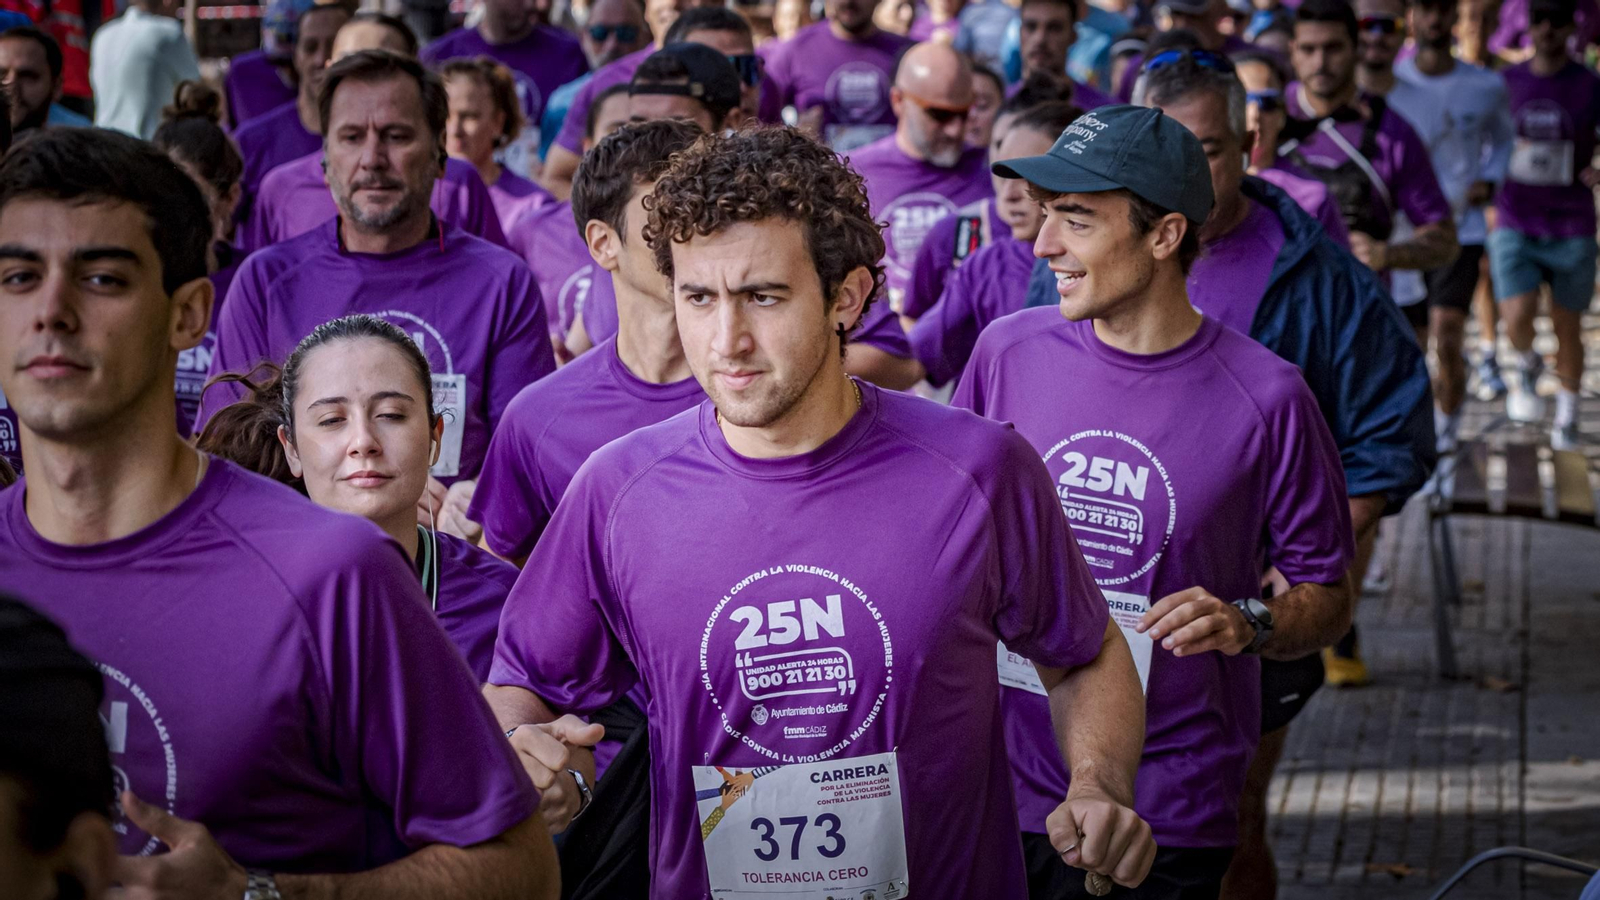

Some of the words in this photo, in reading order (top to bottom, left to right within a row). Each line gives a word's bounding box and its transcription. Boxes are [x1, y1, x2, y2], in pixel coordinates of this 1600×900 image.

[1070, 429, 1101, 442] CONTRA
[1103, 430, 1114, 438] LA
[1115, 431, 1153, 459] VIOLENCIA
[1059, 451, 1150, 501] 25N
[1150, 456, 1169, 481] HACIA
[1164, 481, 1175, 498] LAS
[1088, 511, 1103, 525] 21
[1104, 514, 1119, 528] 21
[1119, 518, 1138, 532] 30
[1166, 498, 1177, 535] MUJERES
[770, 565, 784, 575] LA
[786, 564, 839, 582] VIOLENCIA
[1130, 552, 1162, 580] MACHISTA
[730, 569, 768, 595] CONTRA
[840, 577, 868, 603] HACIA
[866, 601, 882, 620] LAS
[700, 595, 731, 670] INTERNACIONAL
[728, 594, 845, 650] 25N
[878, 620, 893, 667] MUJERES
[745, 665, 776, 676] UNIDAD
[777, 660, 807, 671] ALERTA
[807, 659, 817, 667] 24
[817, 657, 844, 666] HORAS
[702, 672, 713, 690] DÍA
[747, 672, 783, 690] 900
[785, 669, 804, 684] 21
[805, 667, 823, 682] 21
[824, 665, 846, 681] 30
[771, 705, 816, 719] Ayuntamiento
[816, 705, 825, 715] de
[825, 703, 848, 714] Cádiz
[721, 712, 741, 739] CÁDIZ
[741, 735, 779, 760] CONTRA
[782, 754, 795, 763] LA
[797, 738, 851, 763] VIOLENCIA
[850, 692, 887, 741] MACHISTA
[130, 684, 157, 719] HACIA
[154, 717, 170, 742] LAS
[163, 743, 177, 800] MUJERES
[810, 763, 889, 783] CARRERA
[846, 777, 890, 788] ELIMINACIÓN
[854, 784, 890, 794] VIOLENCIA
[860, 790, 892, 800] MUJERES
[750, 812, 847, 862] 373
[742, 869, 825, 884] TOLERANCIA
[828, 866, 869, 881] CERO
